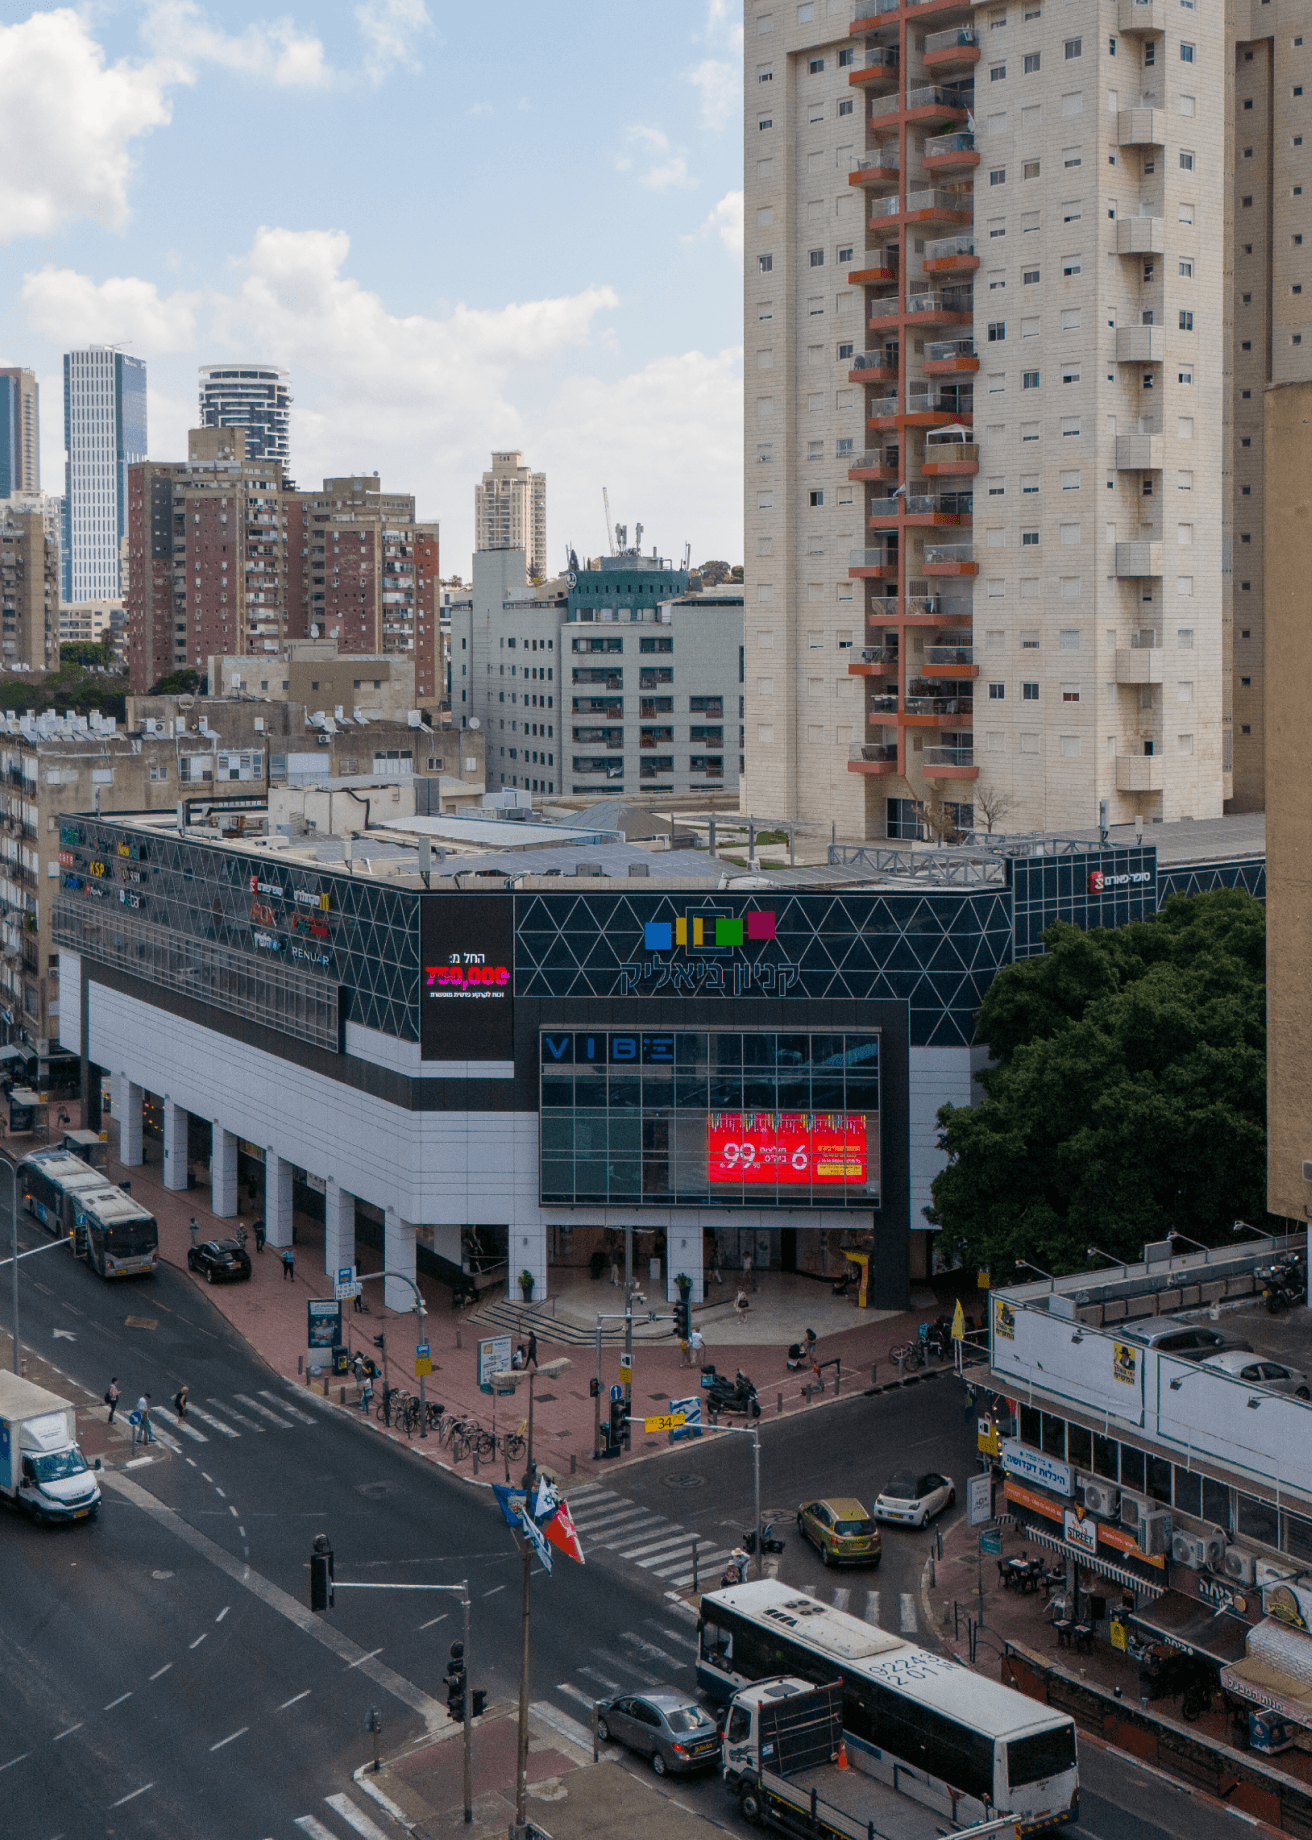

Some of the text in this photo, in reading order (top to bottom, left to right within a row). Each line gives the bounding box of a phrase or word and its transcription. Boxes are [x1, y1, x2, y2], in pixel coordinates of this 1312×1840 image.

[91, 860, 105, 877] KSP
[292, 946, 330, 966] RENUAR
[463, 952, 486, 964] החל
[620, 955, 800, 997] קניון ביאליק
[546, 1037, 674, 1060] VIBE
[723, 1142, 756, 1169] 99
[791, 1144, 808, 1171] 6
[658, 1416, 672, 1430] 34
[1067, 1526, 1094, 1545] STREET
[869, 1653, 940, 1676] 92243
